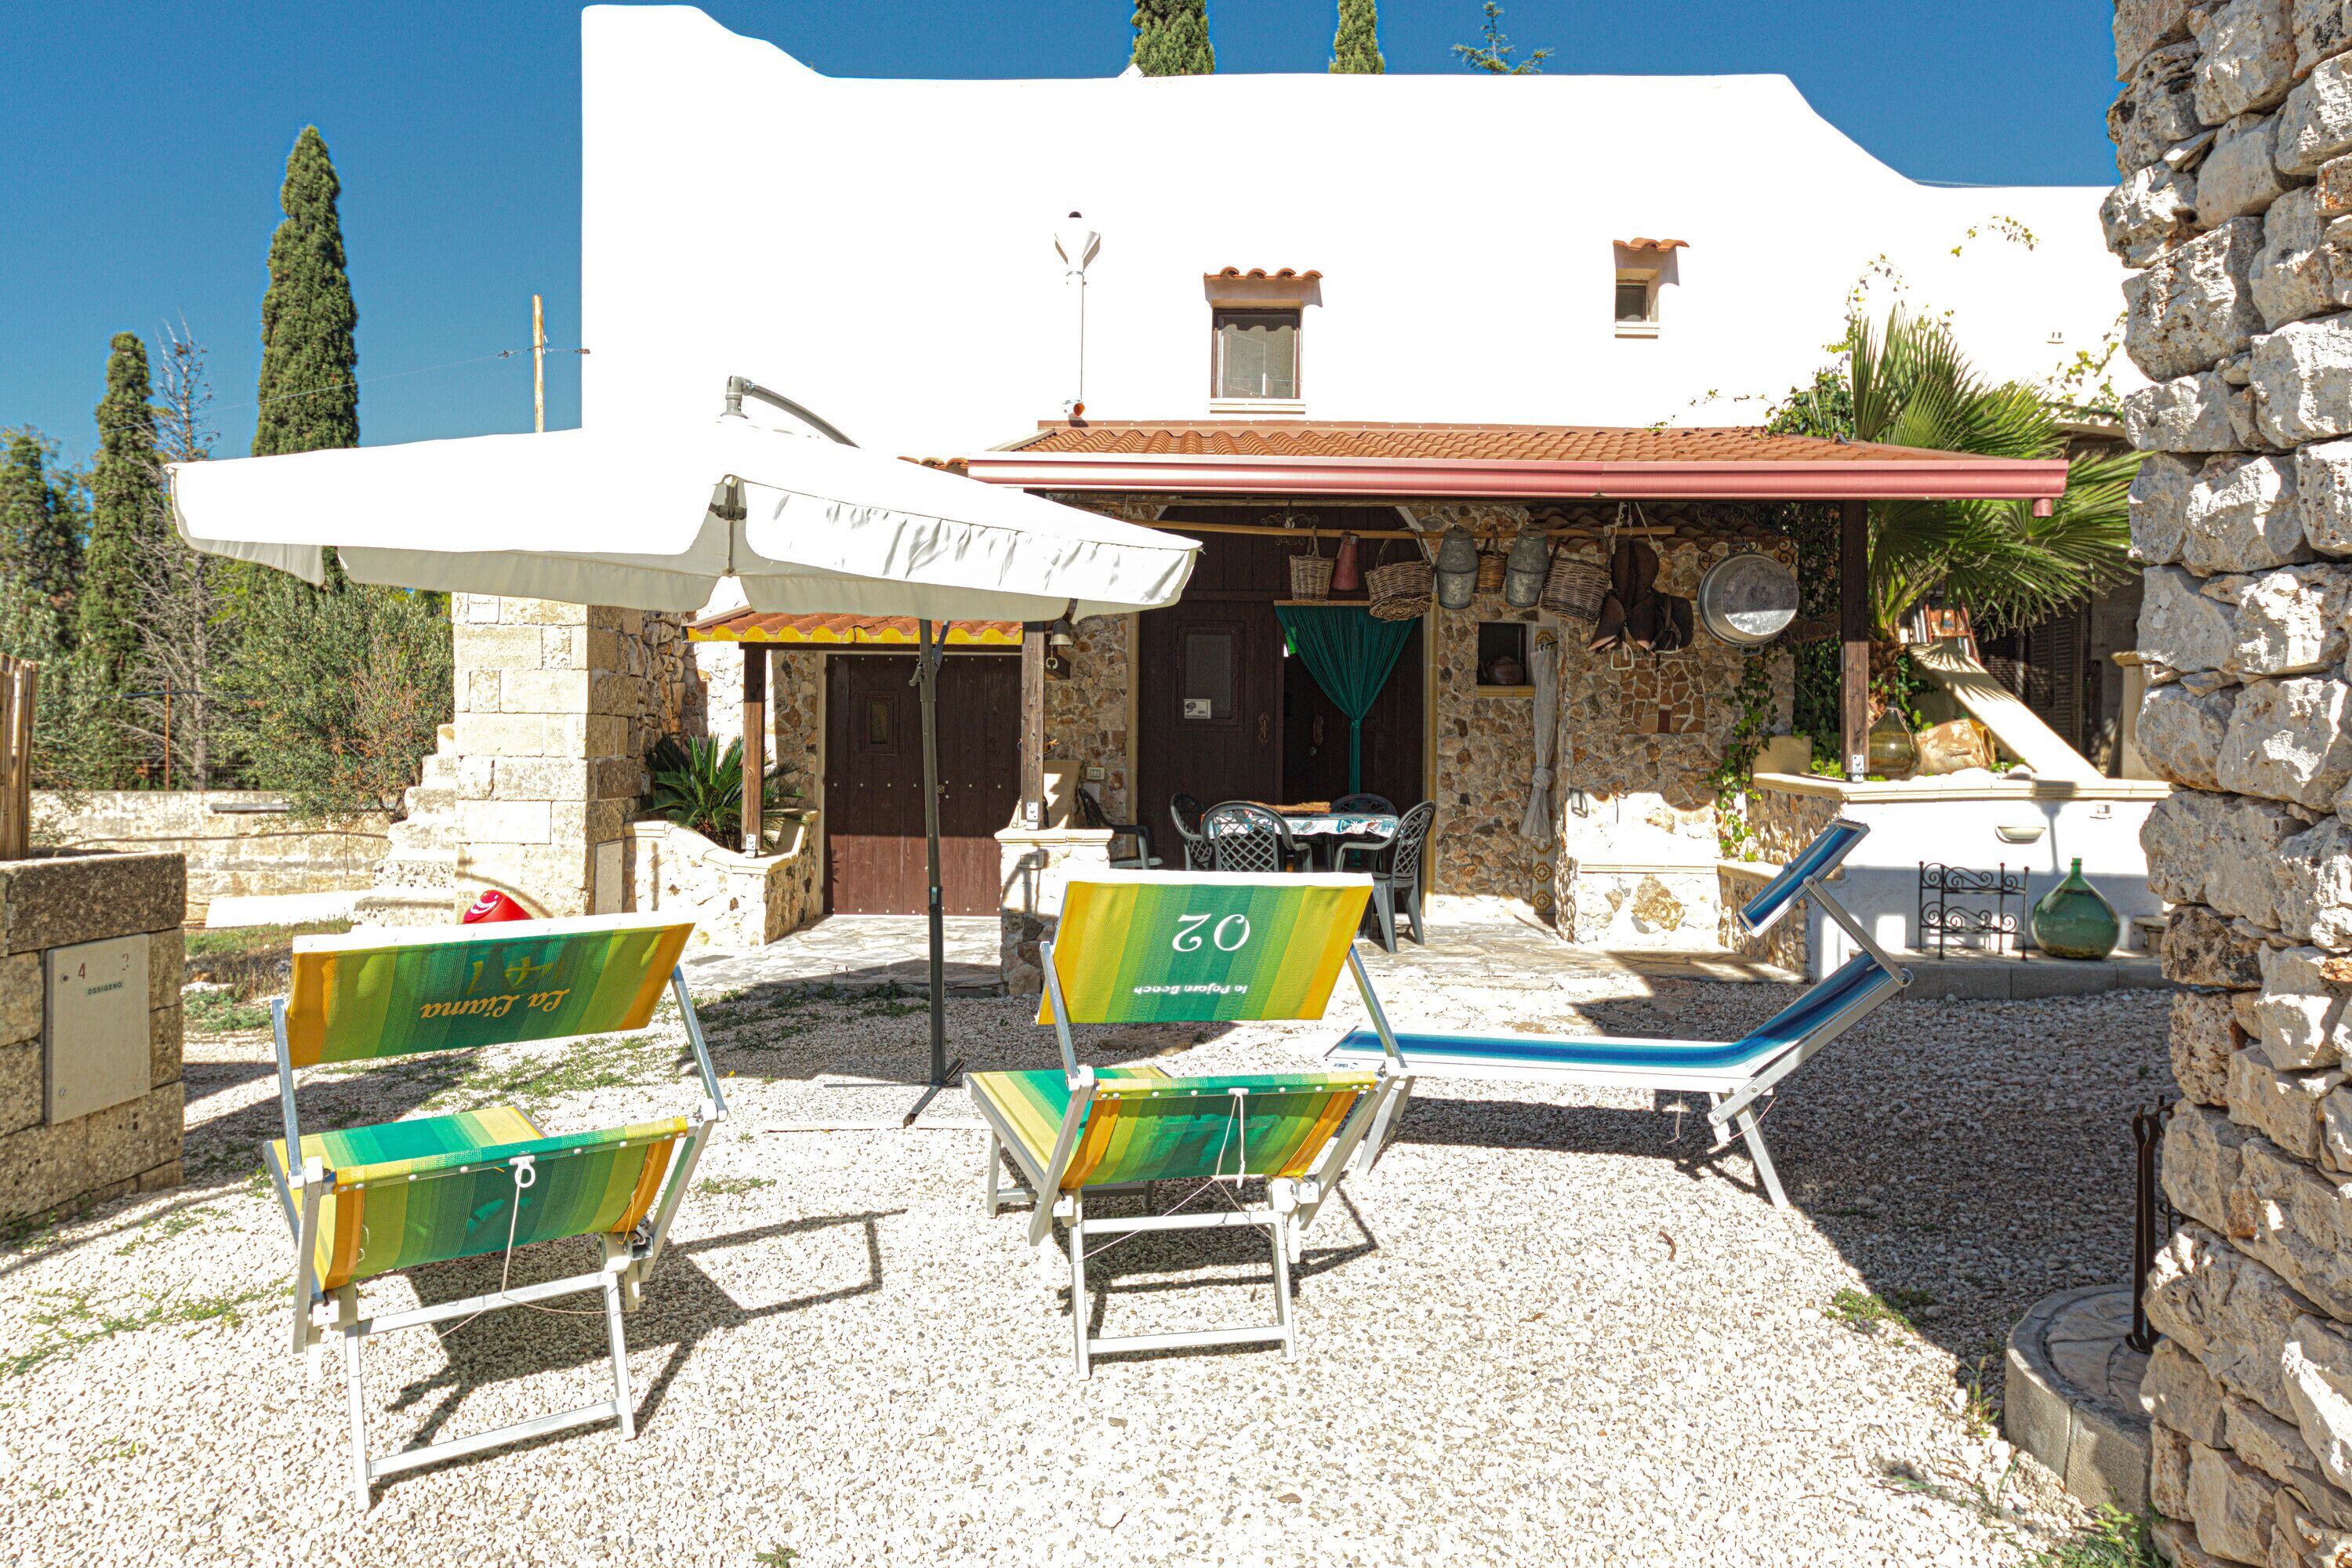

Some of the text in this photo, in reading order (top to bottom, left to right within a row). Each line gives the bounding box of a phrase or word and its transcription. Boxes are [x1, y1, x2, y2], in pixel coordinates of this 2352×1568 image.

[1172, 913, 1250, 952] 02
[78, 963, 85, 979] 4
[87, 982, 122, 996] OSSIGENO
[1134, 985, 1180, 995] Beach
[420, 989, 570, 1018] La Liama
